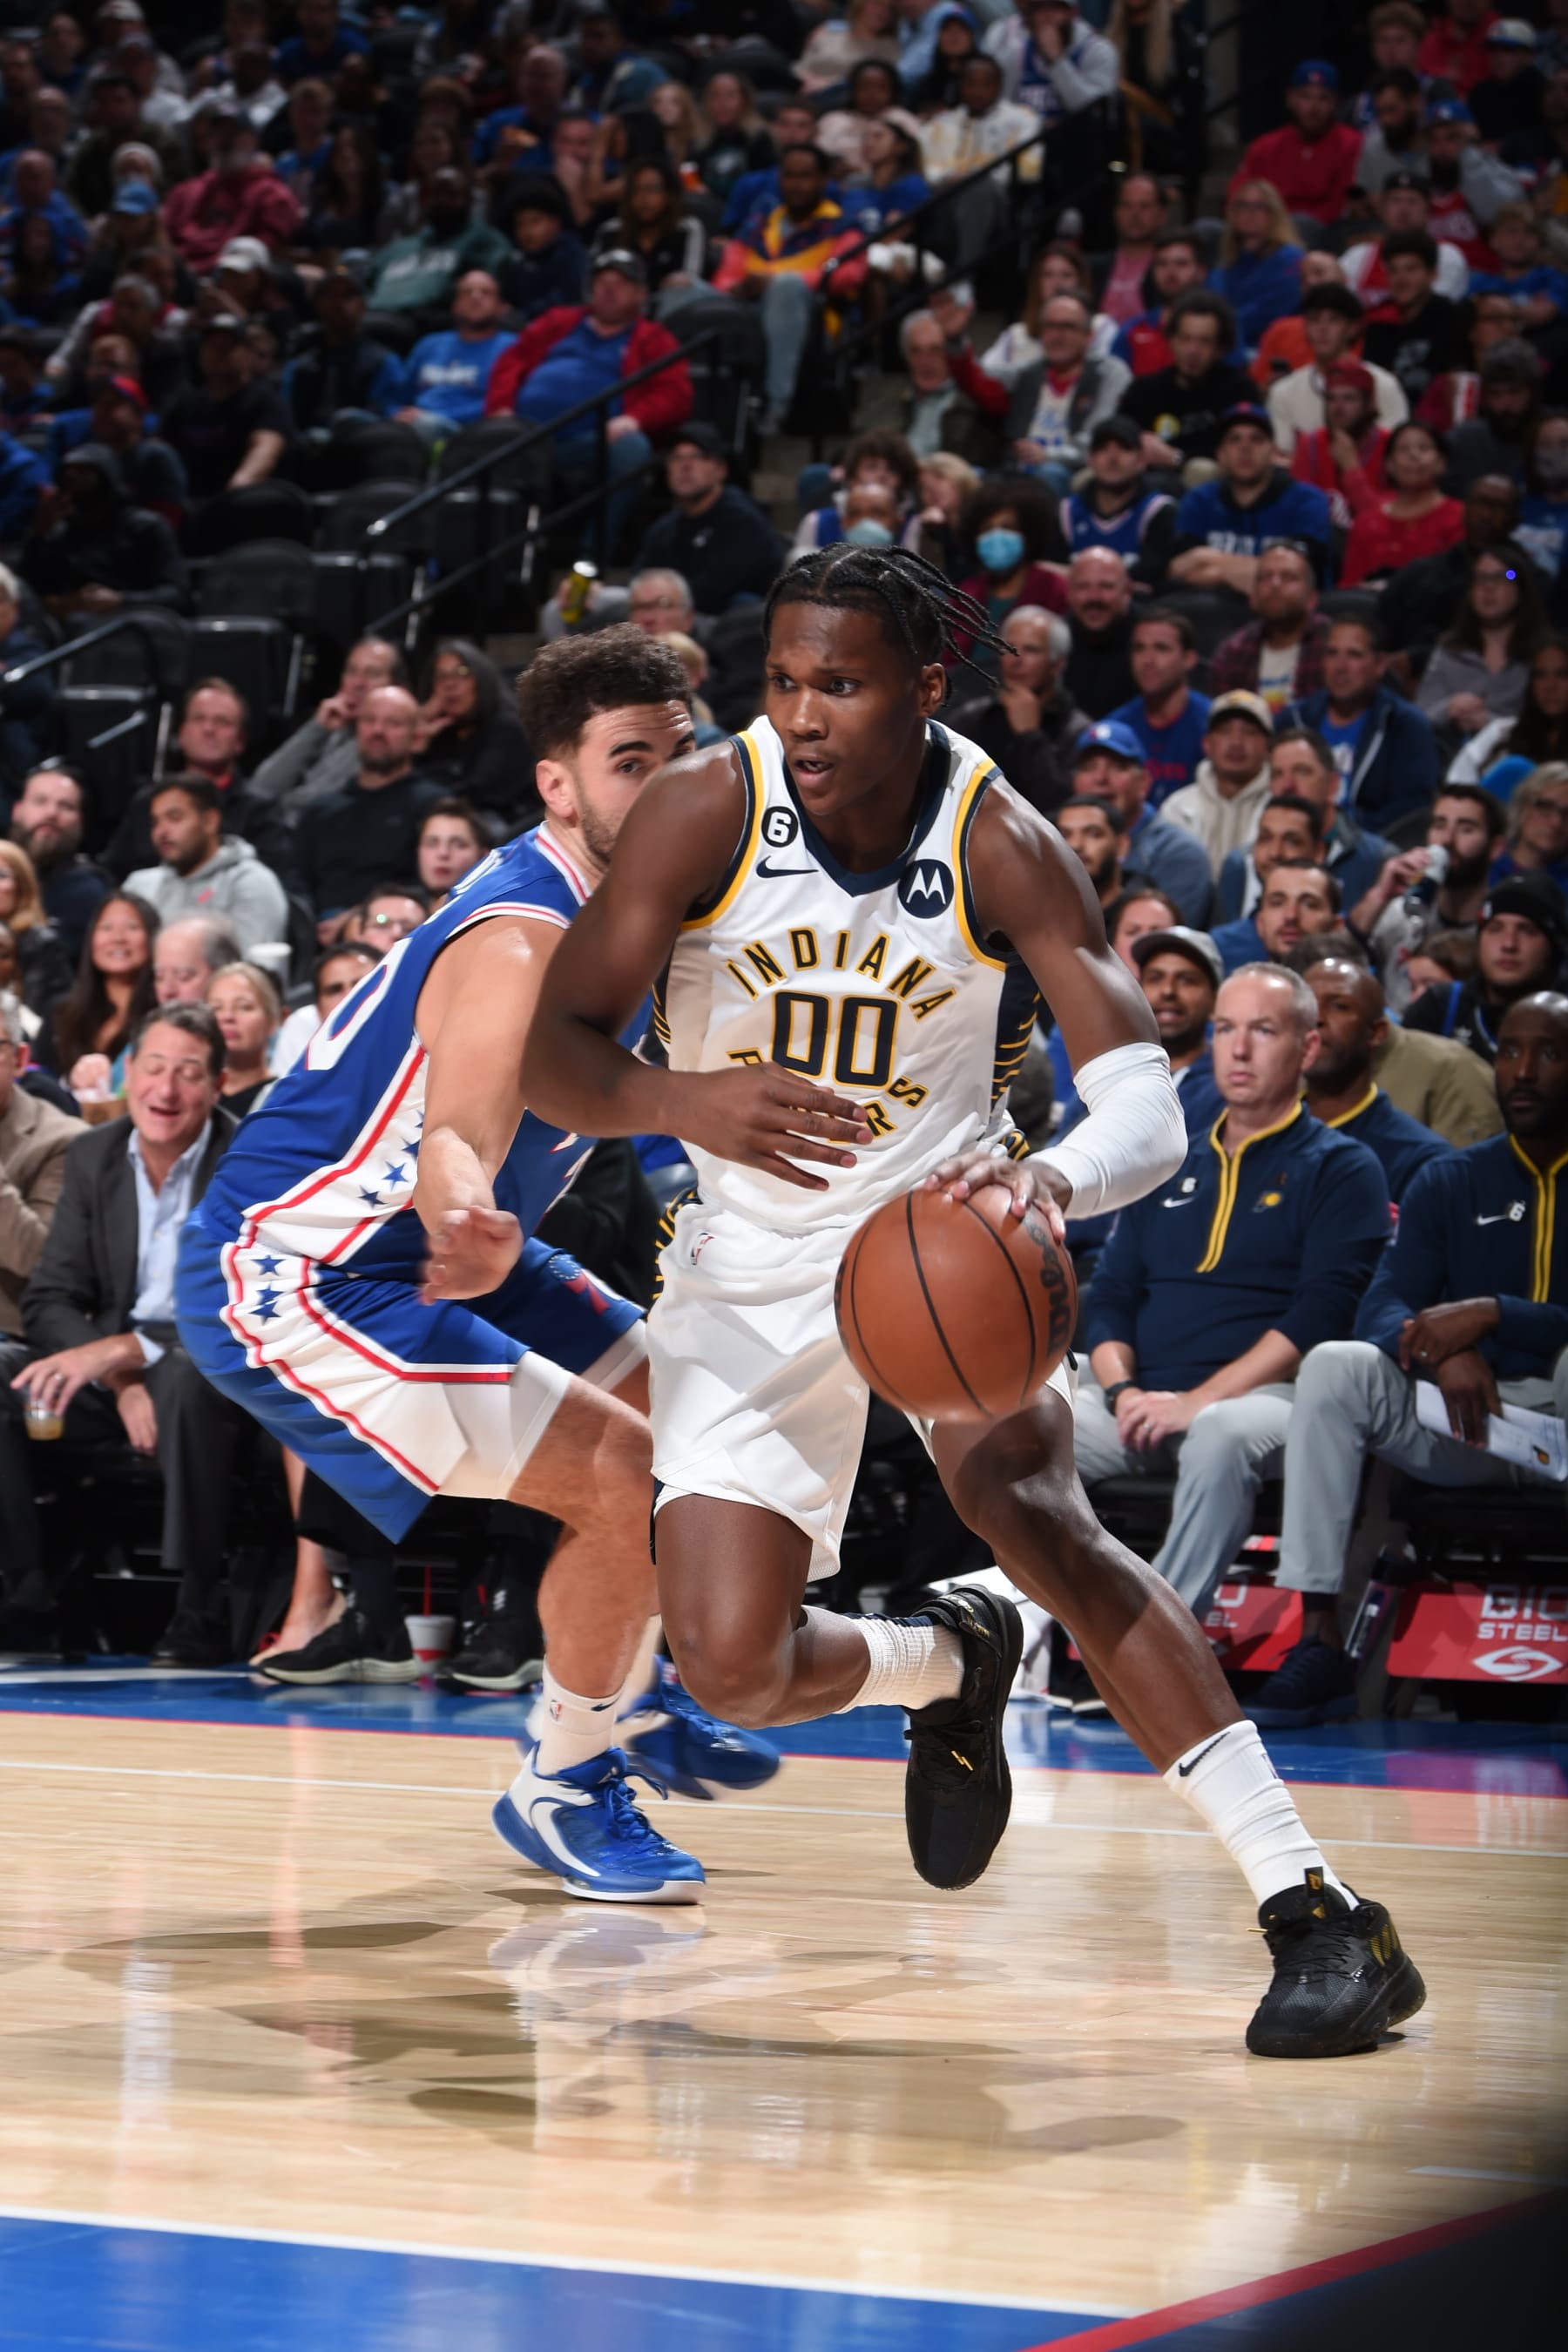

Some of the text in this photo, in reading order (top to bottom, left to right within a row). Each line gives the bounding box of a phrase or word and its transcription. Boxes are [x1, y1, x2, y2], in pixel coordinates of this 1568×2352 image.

[767, 811, 792, 843] 6
[726, 926, 956, 1021] INDIANA
[768, 990, 901, 1088] 00
[726, 1047, 929, 1139] PRS
[1509, 1200, 1526, 1221] 6
[1477, 1622, 1568, 1642] STEEL
